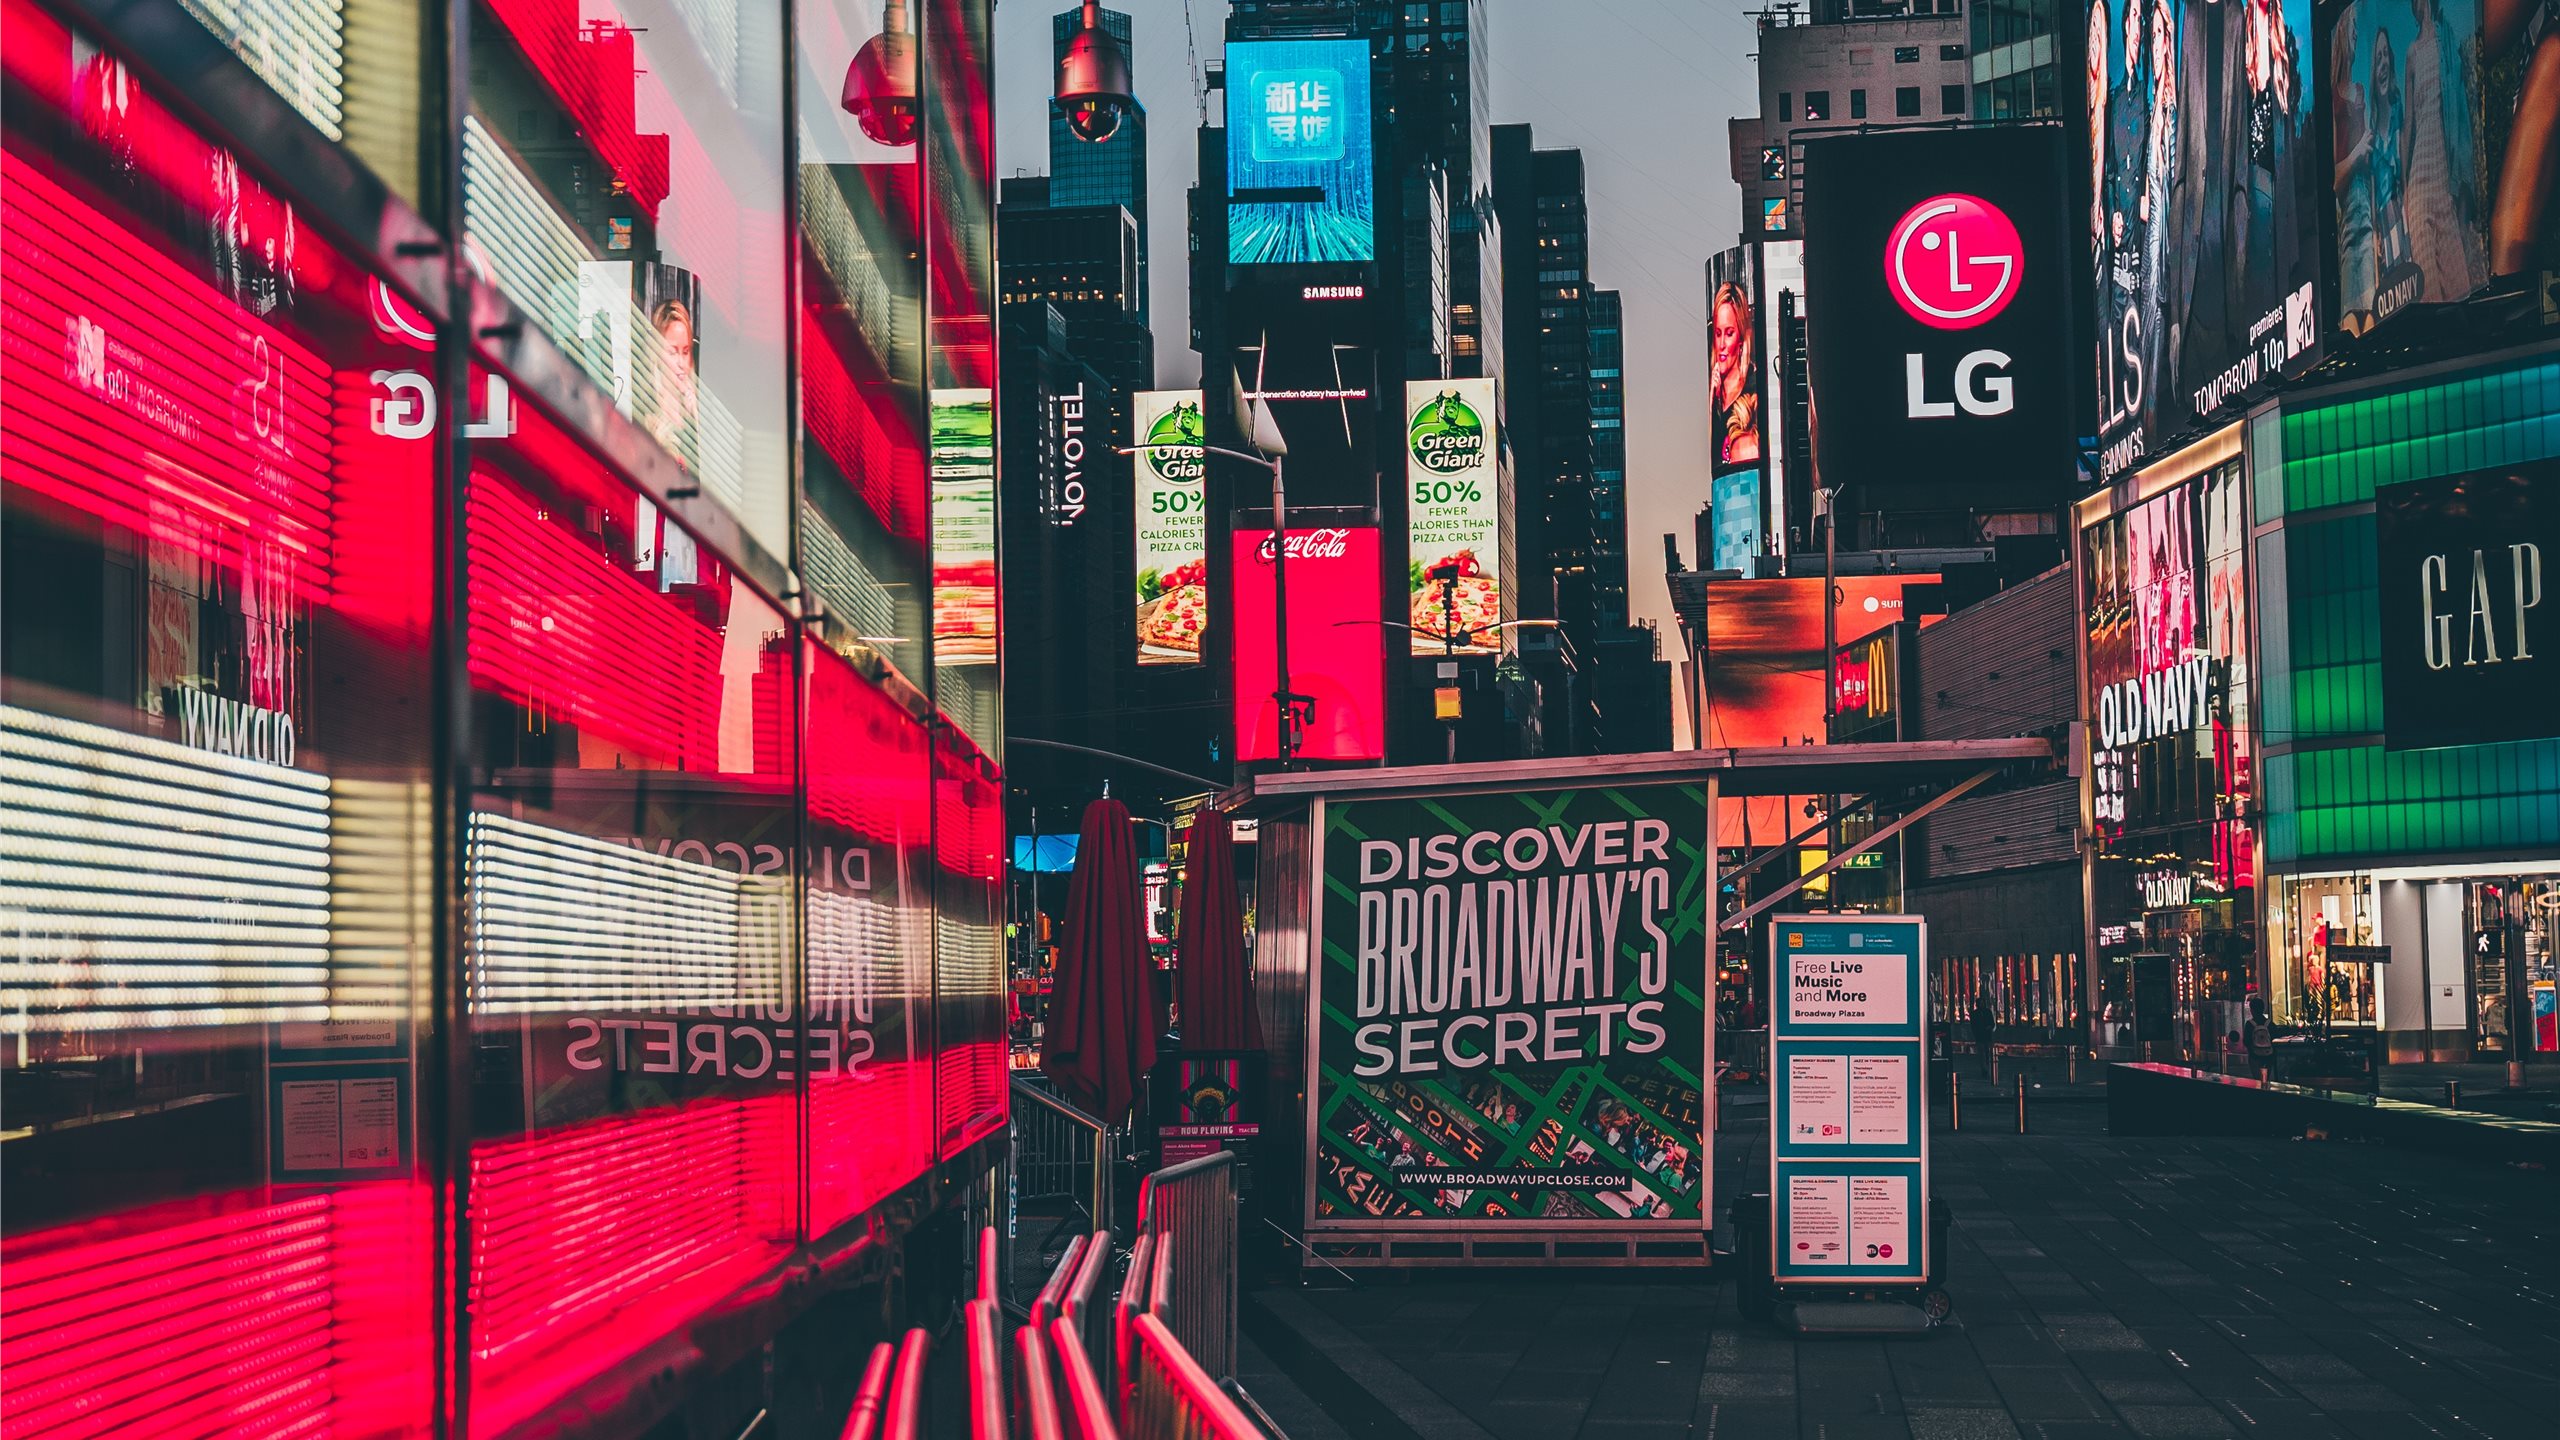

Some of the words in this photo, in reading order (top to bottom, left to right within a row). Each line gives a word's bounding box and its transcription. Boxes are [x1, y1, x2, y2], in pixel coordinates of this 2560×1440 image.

[1265, 81, 1331, 113] 新华
[1303, 286, 1363, 299] SAMSUNG
[2377, 293, 2394, 318] OLD
[2395, 273, 2418, 306] NAVY
[2249, 304, 2283, 346] premieres
[1905, 348, 2014, 418] LG
[2193, 350, 2259, 417] TOMORROW
[2262, 337, 2285, 372] 10p
[1260, 390, 1299, 399] Generation
[1300, 389, 1325, 399] Galaxy
[1325, 389, 1339, 397] has
[1340, 388, 1366, 397] arrived
[1417, 432, 1481, 451] Green
[1060, 382, 1085, 526] NOVOTEL
[1425, 449, 1483, 468] Giant
[1415, 480, 1482, 504] 50%
[1165, 516, 1204, 526] FEWER
[1429, 506, 1468, 517] FEWER
[1461, 518, 1493, 529] THAN
[1140, 528, 1195, 540] CALORIES
[1413, 533, 1445, 543] PIZZA
[1448, 531, 1485, 542] CRUST
[1150, 542, 1181, 552] PIZZA
[2420, 542, 2541, 671] GAP
[2100, 677, 2142, 750] OLD
[2145, 654, 2212, 740] NAVY
[1359, 819, 1670, 885] DISCOVER
[1855, 854, 1871, 867] 44
[2145, 880, 2164, 909] OLD
[2164, 876, 2192, 906] NAVY
[1356, 866, 1670, 1020] BROADWAY'S
[1795, 960, 1827, 974] Free
[1830, 960, 1863, 974] Live
[1795, 975, 1843, 988] Music
[1795, 989, 1822, 1002] and
[1826, 989, 1867, 1002] More
[1795, 1010, 1836, 1018] Broadway
[1352, 1001, 1667, 1077] SECRETS
[1181, 1127, 1199, 1135] NOW
[1200, 1125, 1234, 1135] PLAYING
[1391, 1080, 1483, 1161] BOOTH
[1399, 1171, 1627, 1187] WWW.BROADWAYUPCLOSE.COM
